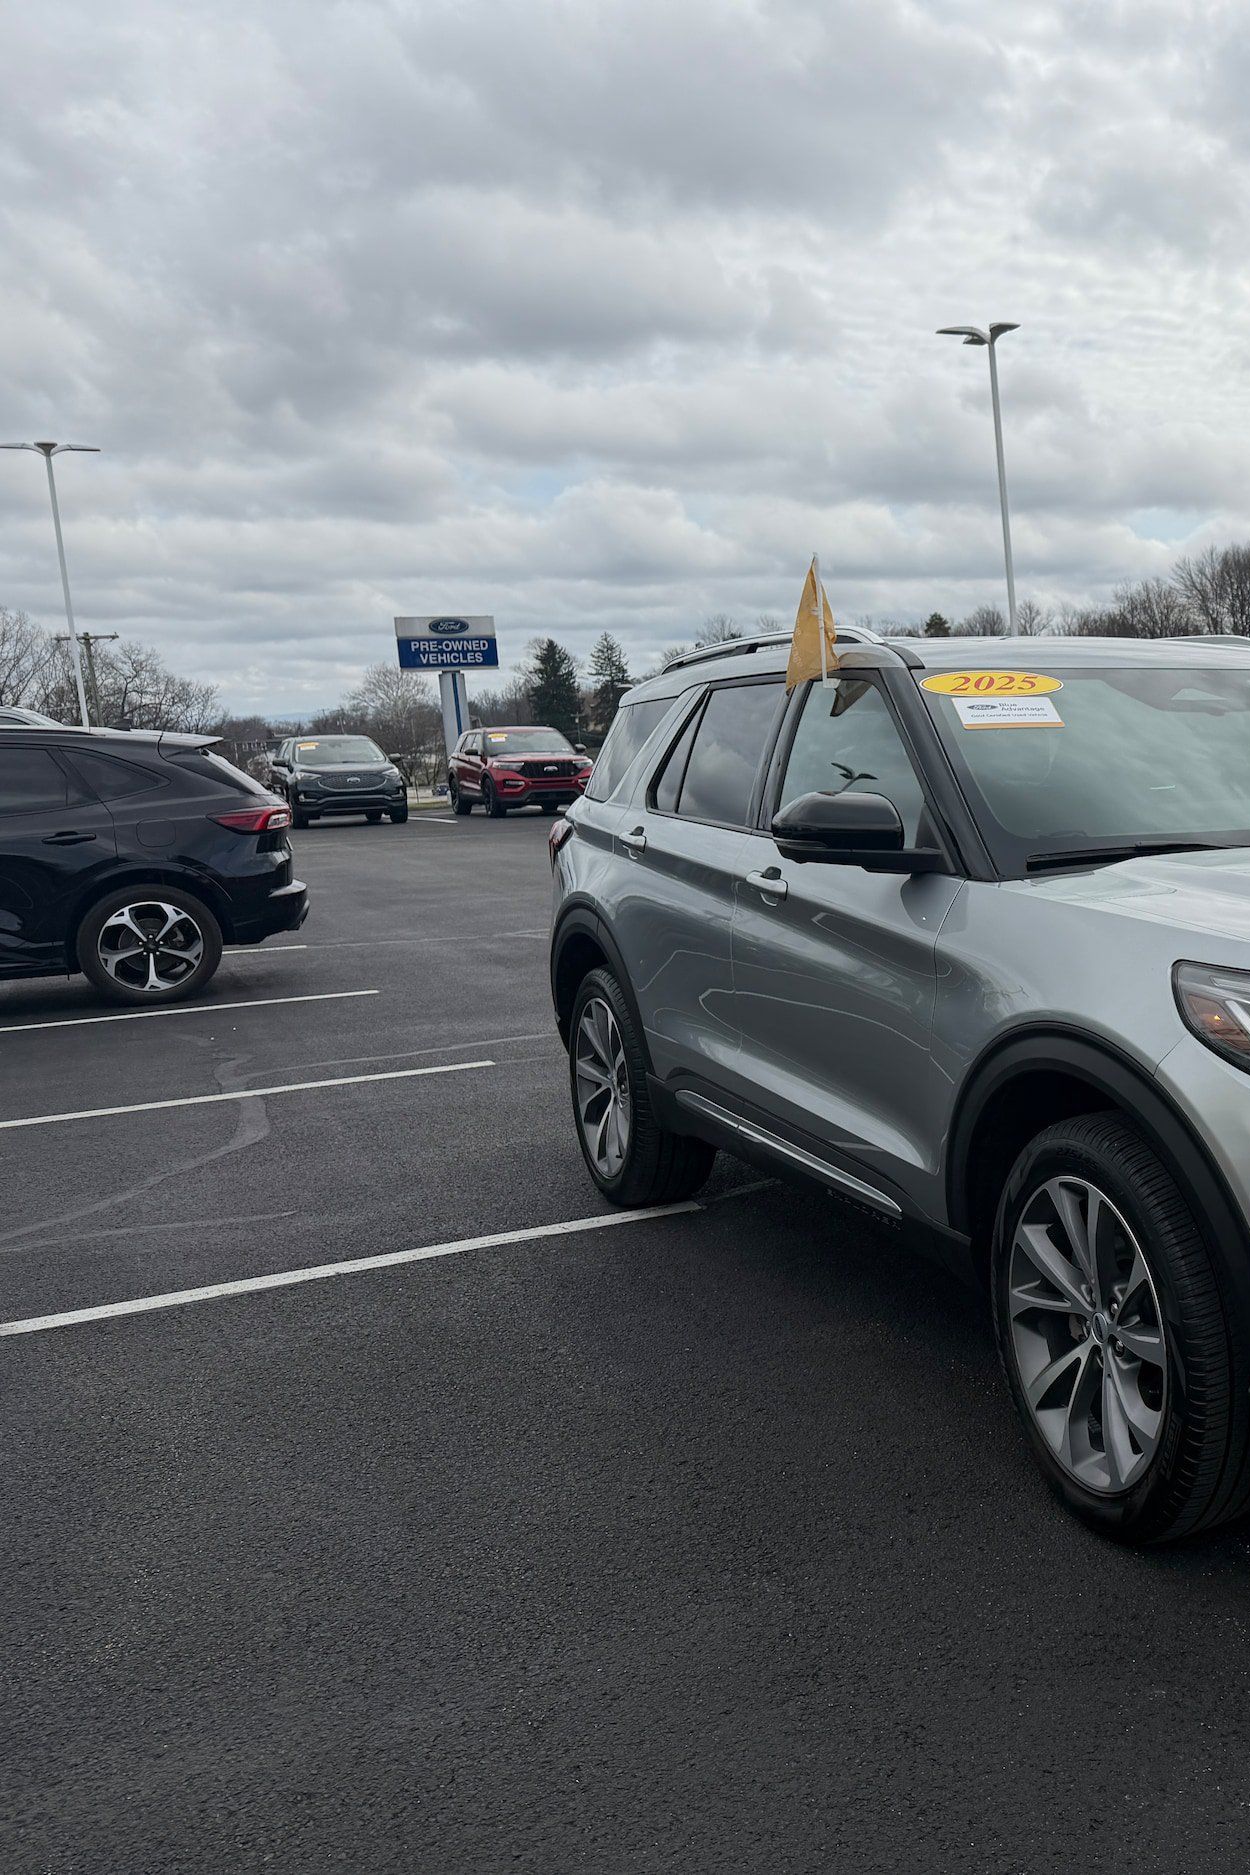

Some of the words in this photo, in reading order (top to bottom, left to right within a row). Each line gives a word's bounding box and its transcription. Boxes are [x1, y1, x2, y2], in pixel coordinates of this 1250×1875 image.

[437, 621, 461, 631] Ford
[410, 640, 489, 652] PRE-OWNED
[419, 652, 484, 664] VEHICLES
[949, 675, 1040, 692] 2025
